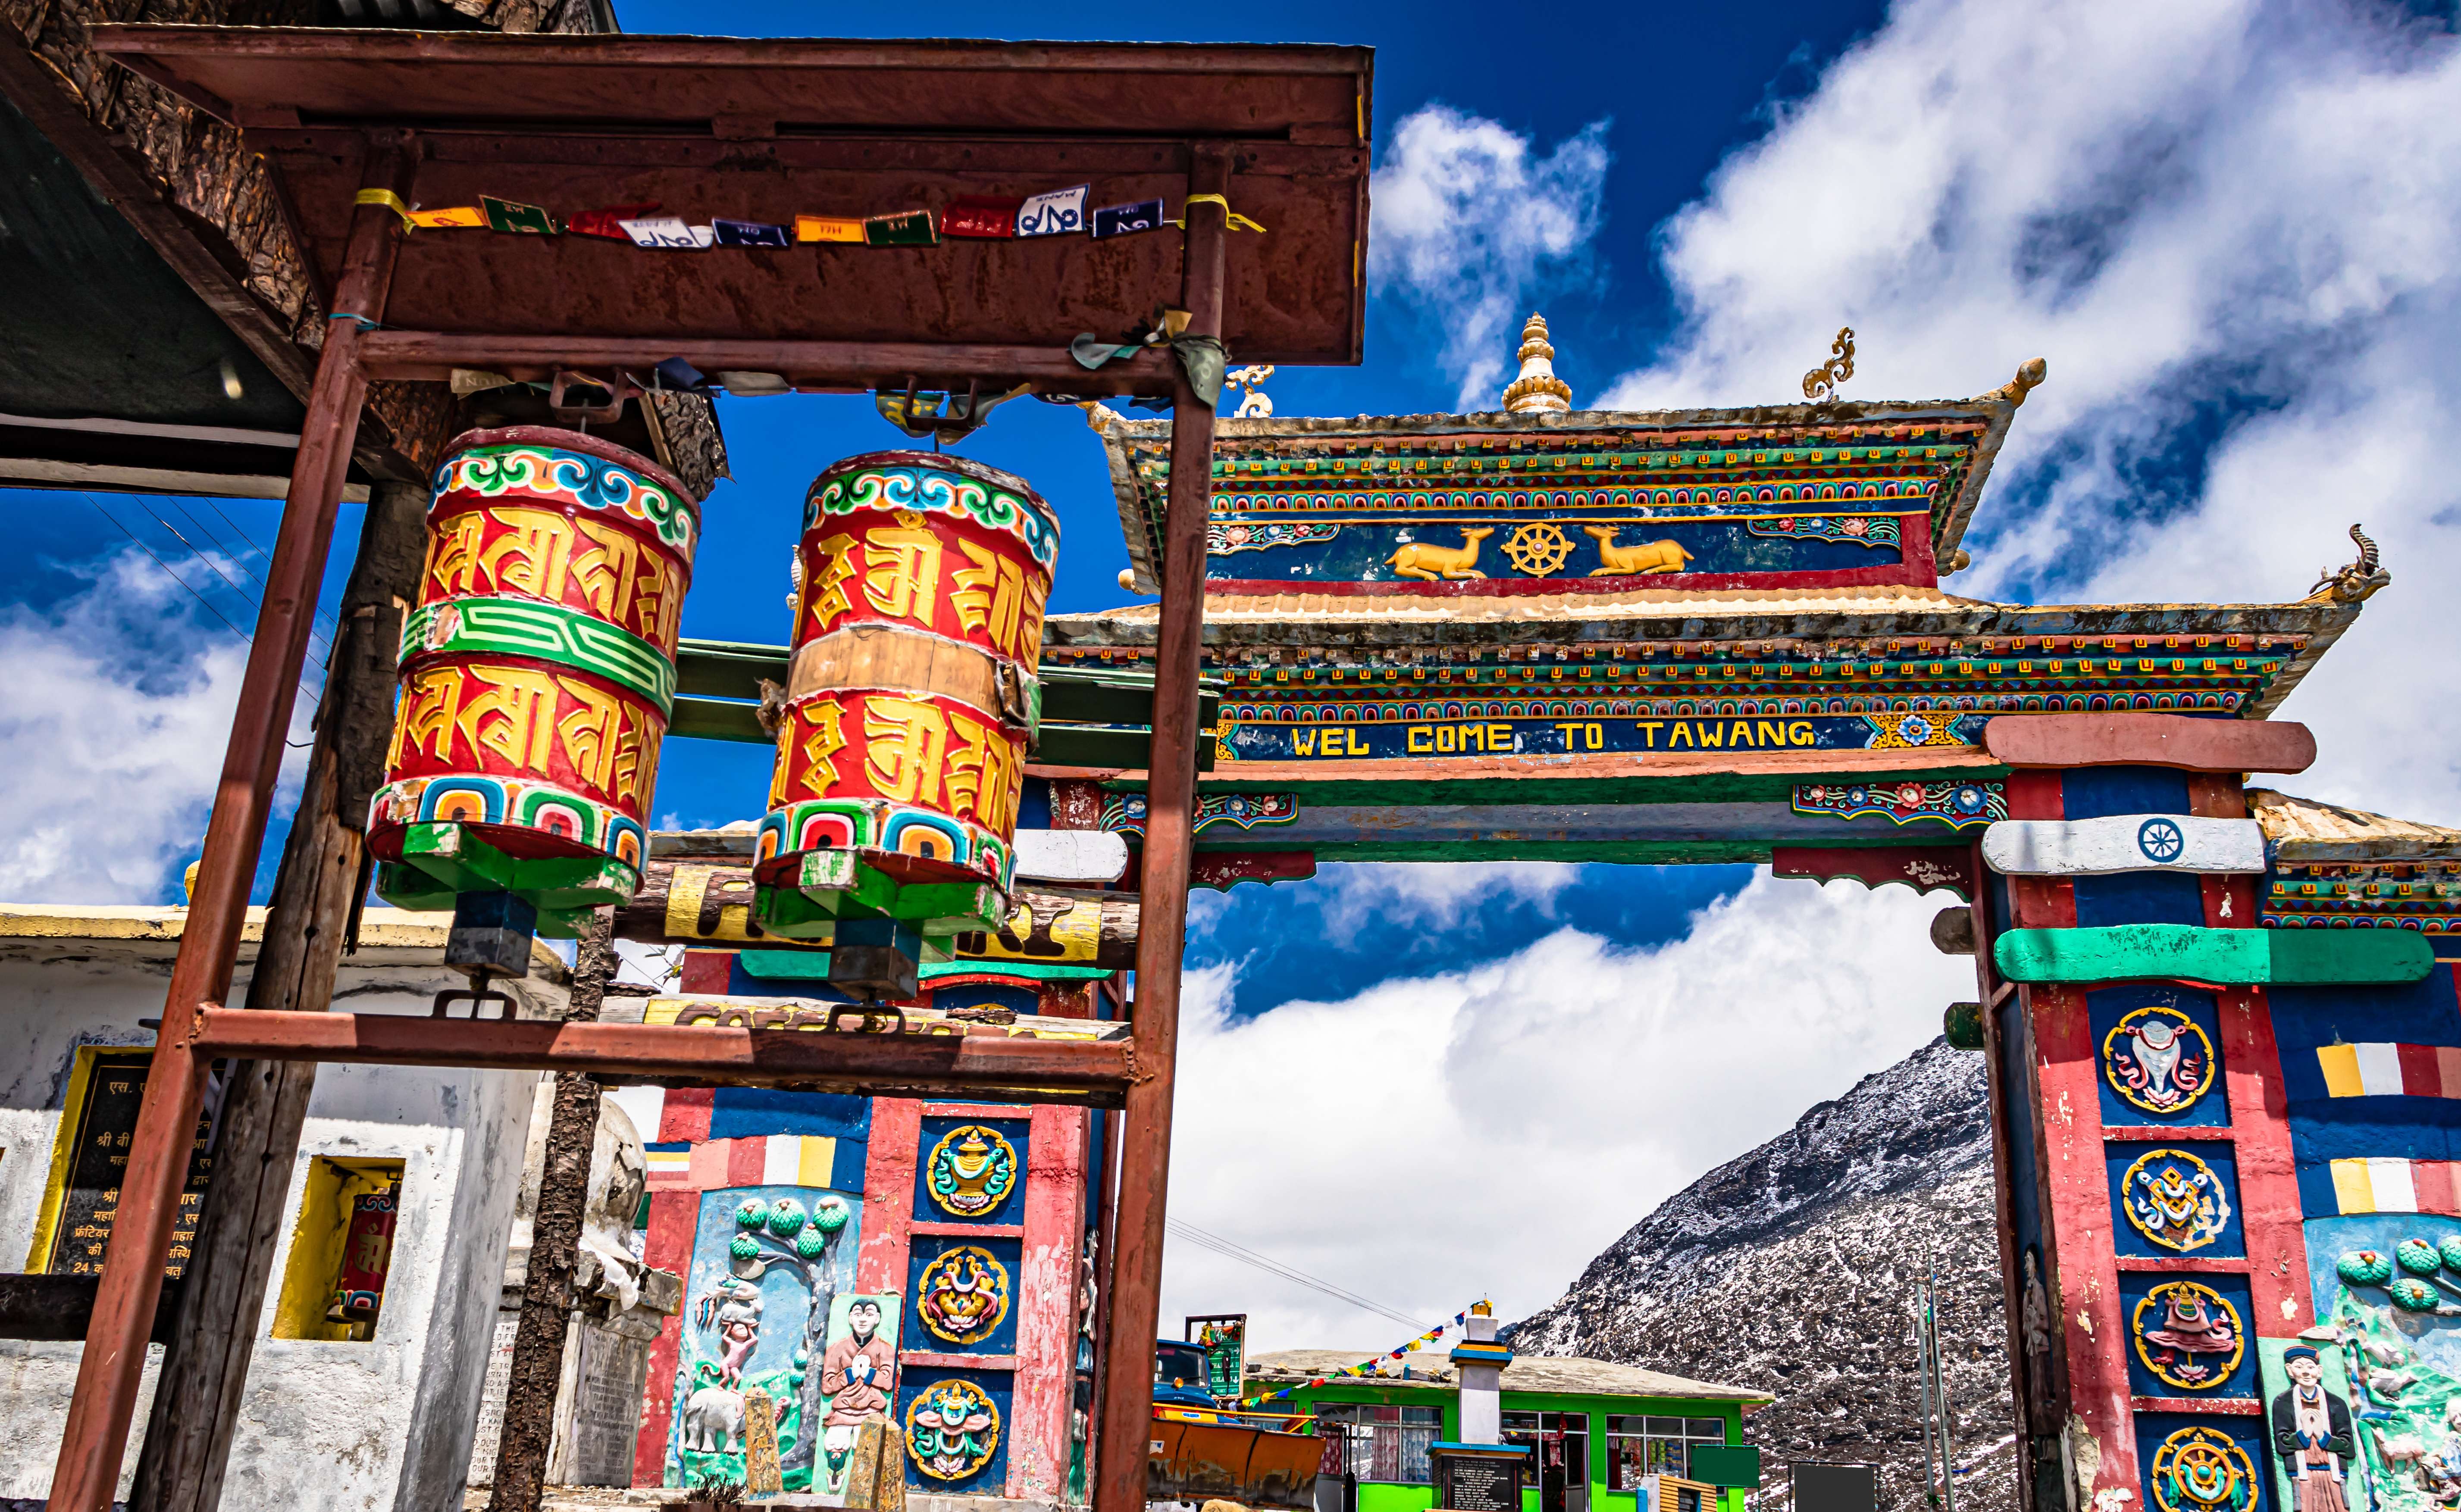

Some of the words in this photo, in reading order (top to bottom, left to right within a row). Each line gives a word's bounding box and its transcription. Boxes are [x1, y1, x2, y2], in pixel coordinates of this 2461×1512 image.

[1292, 728, 1369, 756] WEL
[1408, 724, 1513, 752] COME
[1555, 723, 1603, 750] TO
[1637, 722, 1814, 747] TAWANG
[88, 1243, 103, 1256] की
[73, 1262, 89, 1273] 24
